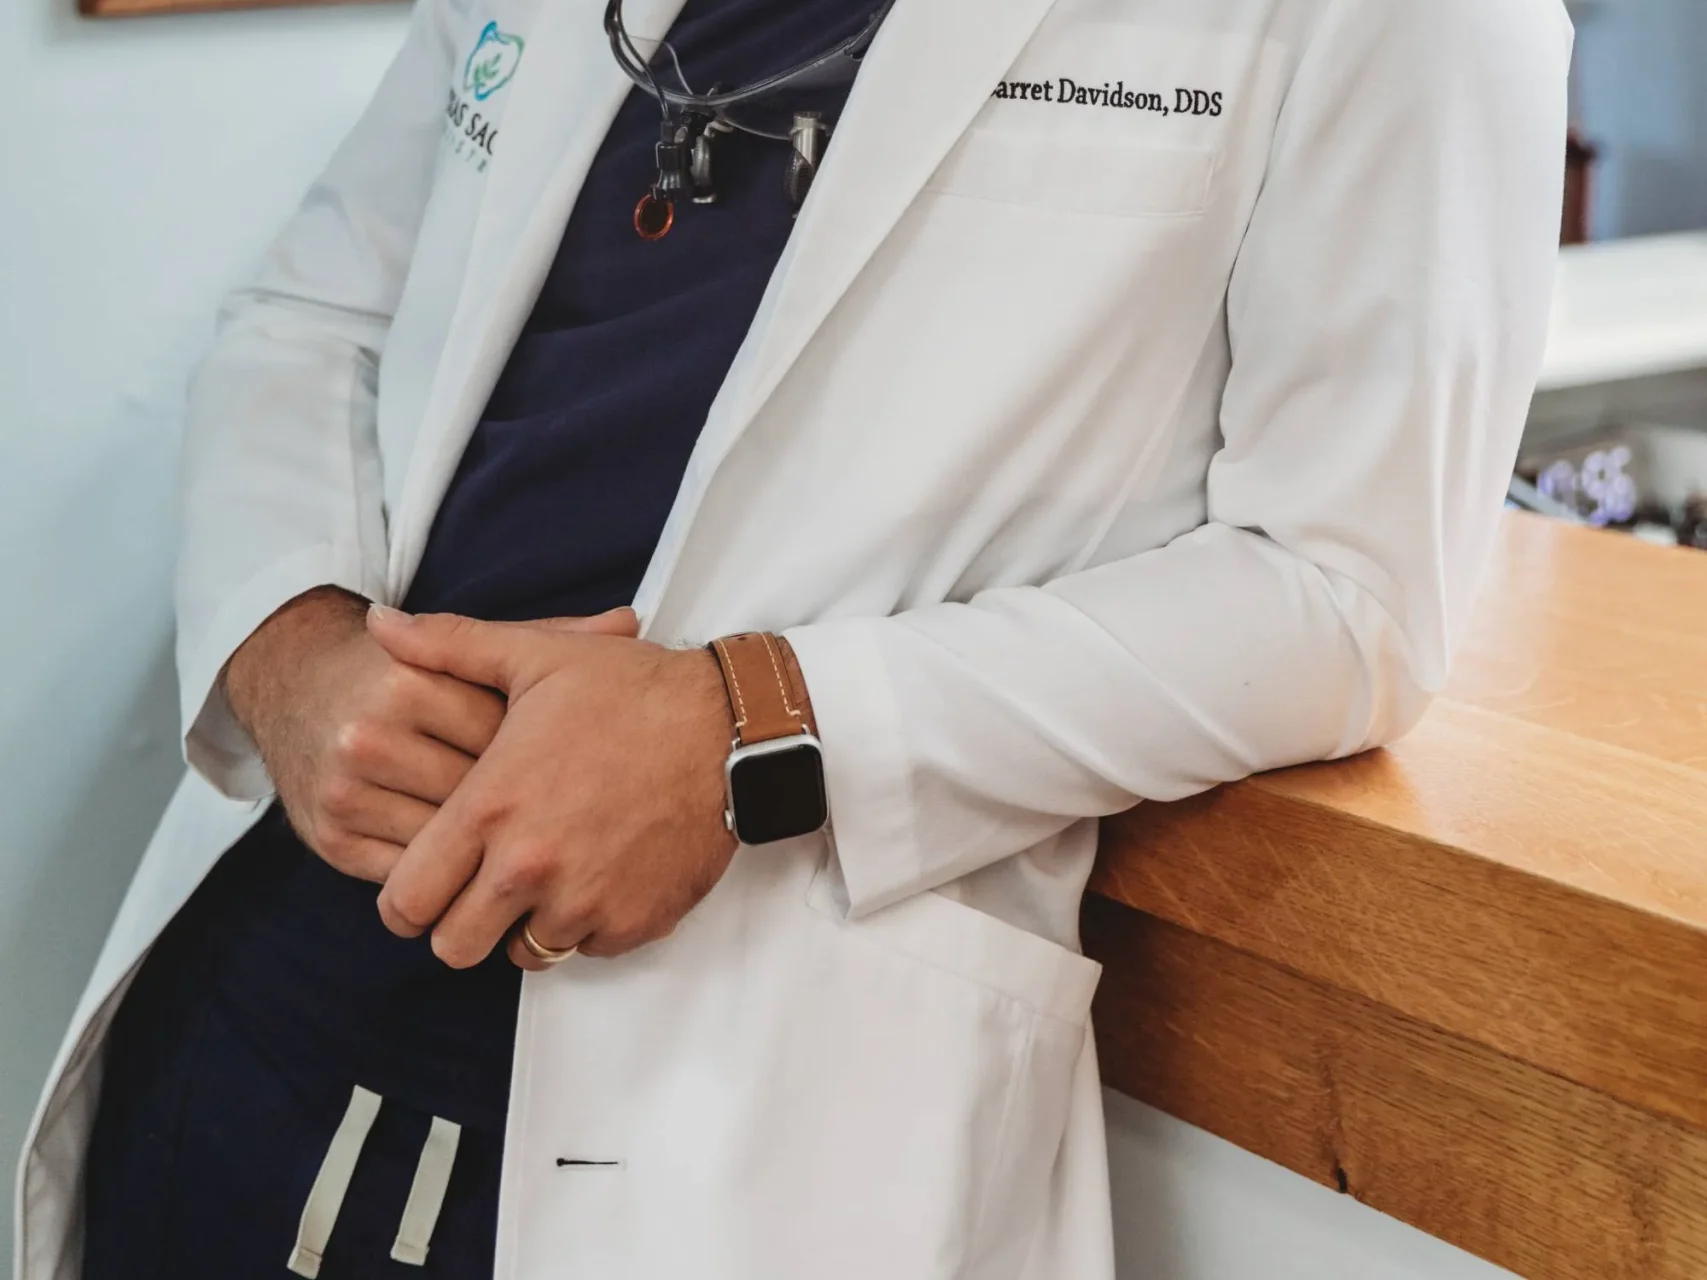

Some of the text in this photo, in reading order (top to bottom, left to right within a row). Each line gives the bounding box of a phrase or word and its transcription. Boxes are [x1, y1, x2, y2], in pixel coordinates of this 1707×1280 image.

[990, 78, 1223, 117] arret Davidson, DDS
